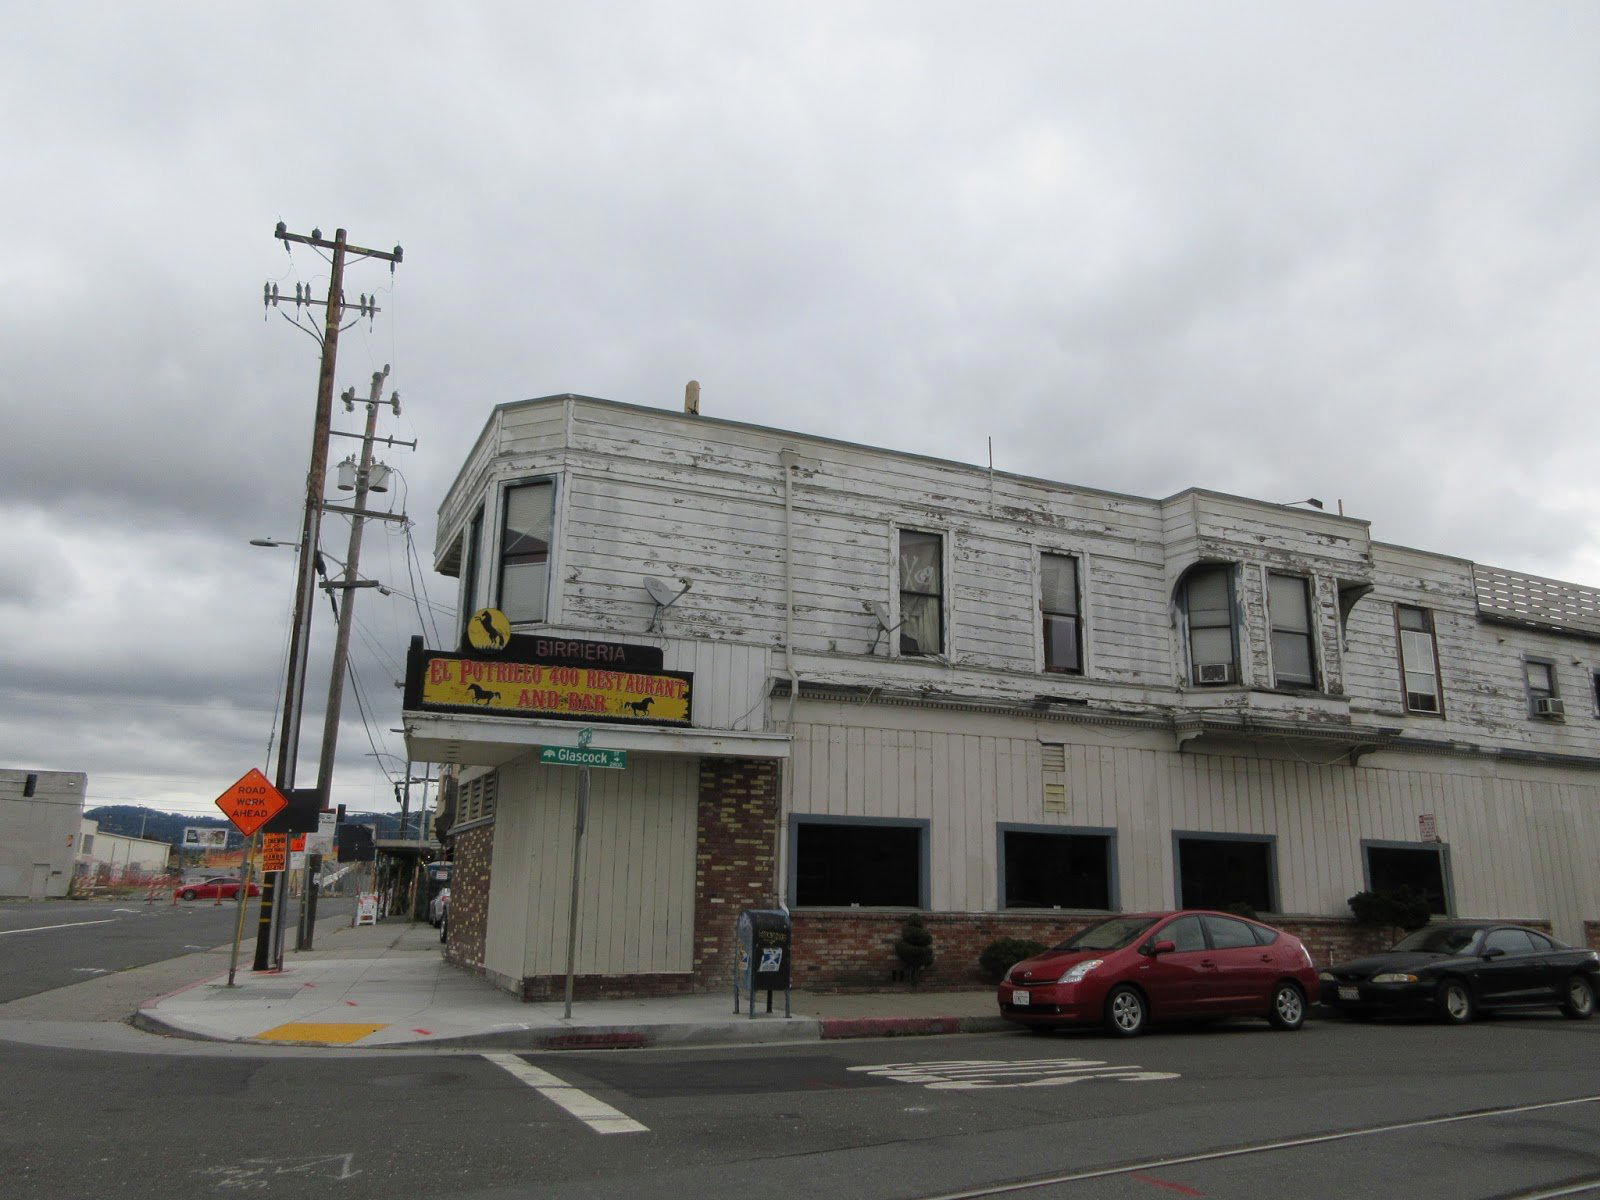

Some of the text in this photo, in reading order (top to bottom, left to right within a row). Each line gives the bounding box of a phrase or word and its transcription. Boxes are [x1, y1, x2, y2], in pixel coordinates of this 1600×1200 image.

[536, 640, 626, 661] BIRRIERIA
[549, 666, 580, 687] 400
[586, 669, 688, 699] RESTAURANT
[518, 688, 607, 712] AND BAR
[558, 748, 608, 764] Glascock
[238, 786, 266, 795] ROAD
[237, 798, 265, 806] WORK
[232, 809, 268, 817] AHEAD
